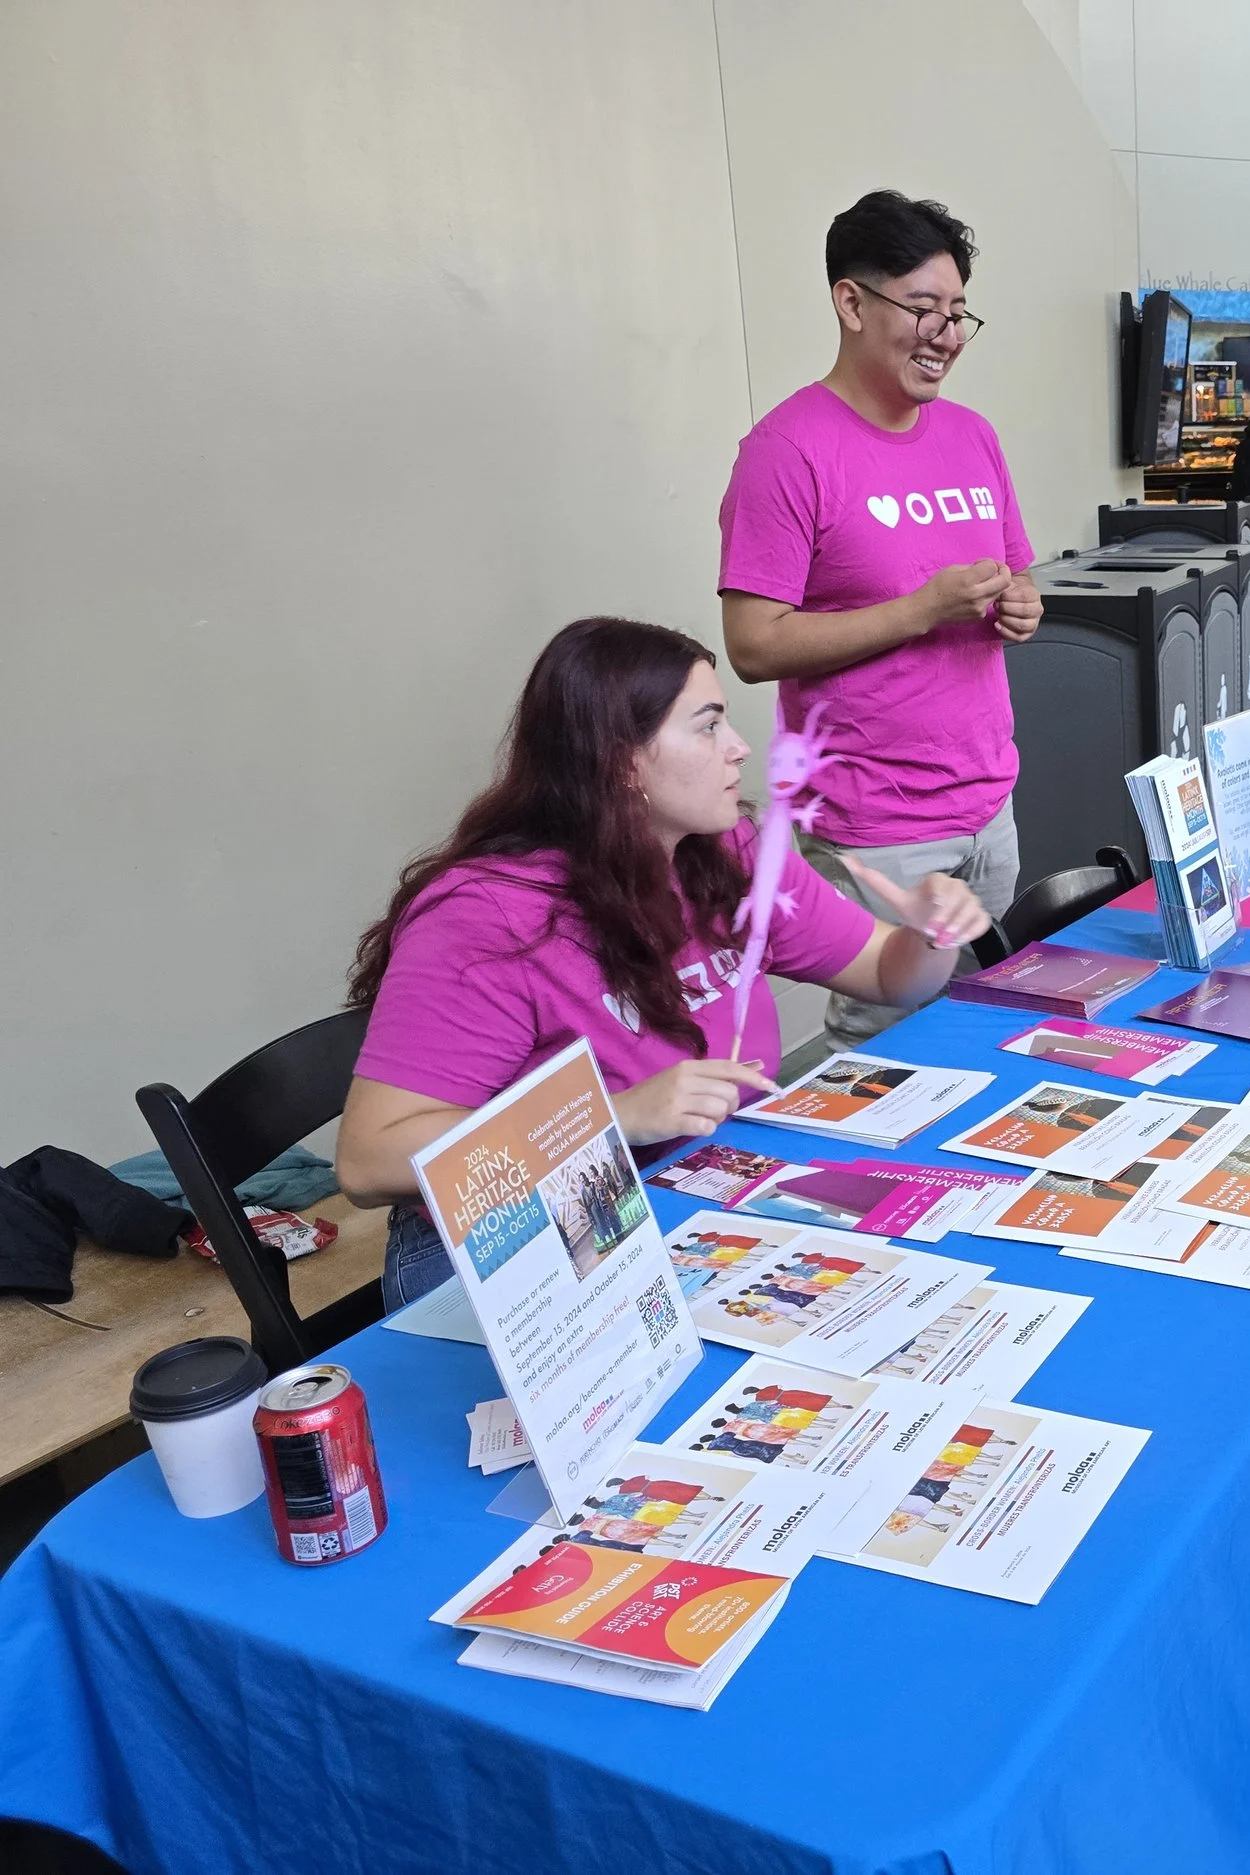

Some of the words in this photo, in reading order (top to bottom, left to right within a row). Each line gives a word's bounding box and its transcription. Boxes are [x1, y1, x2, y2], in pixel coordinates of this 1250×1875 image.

[1176, 270, 1222, 291] Whale
[1083, 1033, 1172, 1056] MEMBERSHIP
[1096, 1029, 1187, 1048] MEMBERSHIP
[528, 1120, 554, 1142] Celebrate
[553, 1105, 570, 1122] LatinX
[569, 1090, 593, 1111] Heritage
[539, 1133, 555, 1152] month
[554, 1128, 562, 1139] by
[560, 1110, 589, 1132] becoming
[464, 1145, 489, 1169] 2024
[547, 1139, 570, 1161] MOLAA
[455, 1145, 515, 1202] LATINX
[454, 1160, 531, 1231] HERITAGE
[471, 1185, 531, 1245] MONTH
[476, 1241, 495, 1264] SEP
[494, 1232, 506, 1248] 15
[510, 1211, 528, 1235] OCT
[529, 1204, 539, 1219] 15
[497, 1296, 530, 1329] Purchase
[530, 1288, 538, 1299] or
[538, 1268, 560, 1292] renew
[516, 1334, 555, 1374] September
[554, 1323, 565, 1337] 15,
[564, 1306, 582, 1327] 2024
[582, 1291, 595, 1309] and
[594, 1270, 619, 1296] October
[618, 1261, 629, 1275] 15,
[627, 1244, 643, 1265] 2024
[907, 1286, 936, 1309] molaa
[504, 1335, 511, 1343] a
[510, 1295, 553, 1338] membership
[1012, 1320, 1039, 1345] molaa
[509, 1326, 541, 1358] between
[522, 1369, 538, 1388] and
[538, 1352, 558, 1376] enjoy
[557, 1343, 566, 1354] an
[566, 1324, 584, 1344] extra
[529, 1389, 541, 1404] six
[541, 1362, 567, 1391] months
[567, 1350, 577, 1365] of
[575, 1310, 615, 1356] membership
[614, 1295, 630, 1317] free!
[545, 1339, 638, 1443] molaa.org/become-a-member
[273, 1417, 304, 1430] Coke
[305, 1406, 340, 1427] ZERO
[582, 1399, 606, 1431] molaa
[845, 1424, 890, 1471] TRANSFRONTERIZAS
[892, 1421, 921, 1452] molaa
[1062, 1458, 1090, 1494] molaa
[966, 1505, 1001, 1547] CROSS-BORDER
[1015, 1460, 1036, 1487] Alejandra
[997, 1511, 1020, 1538] MUJERES
[1017, 1462, 1056, 1514] TRANSFRONTERIZAS
[714, 1521, 740, 1545] Alejandra
[736, 1503, 755, 1520] Phelts
[762, 1515, 798, 1552] molaa
[532, 1574, 565, 1593] Getty
[587, 1562, 643, 1604] EXHIBITION
[652, 1582, 668, 1600] ART
[667, 1582, 681, 1600] PST
[556, 1602, 592, 1625] GUIDE
[602, 1601, 644, 1632] COLLIDE
[614, 1603, 656, 1635] SCIENCE
[638, 1620, 649, 1628] &
[651, 1605, 667, 1621] ART
